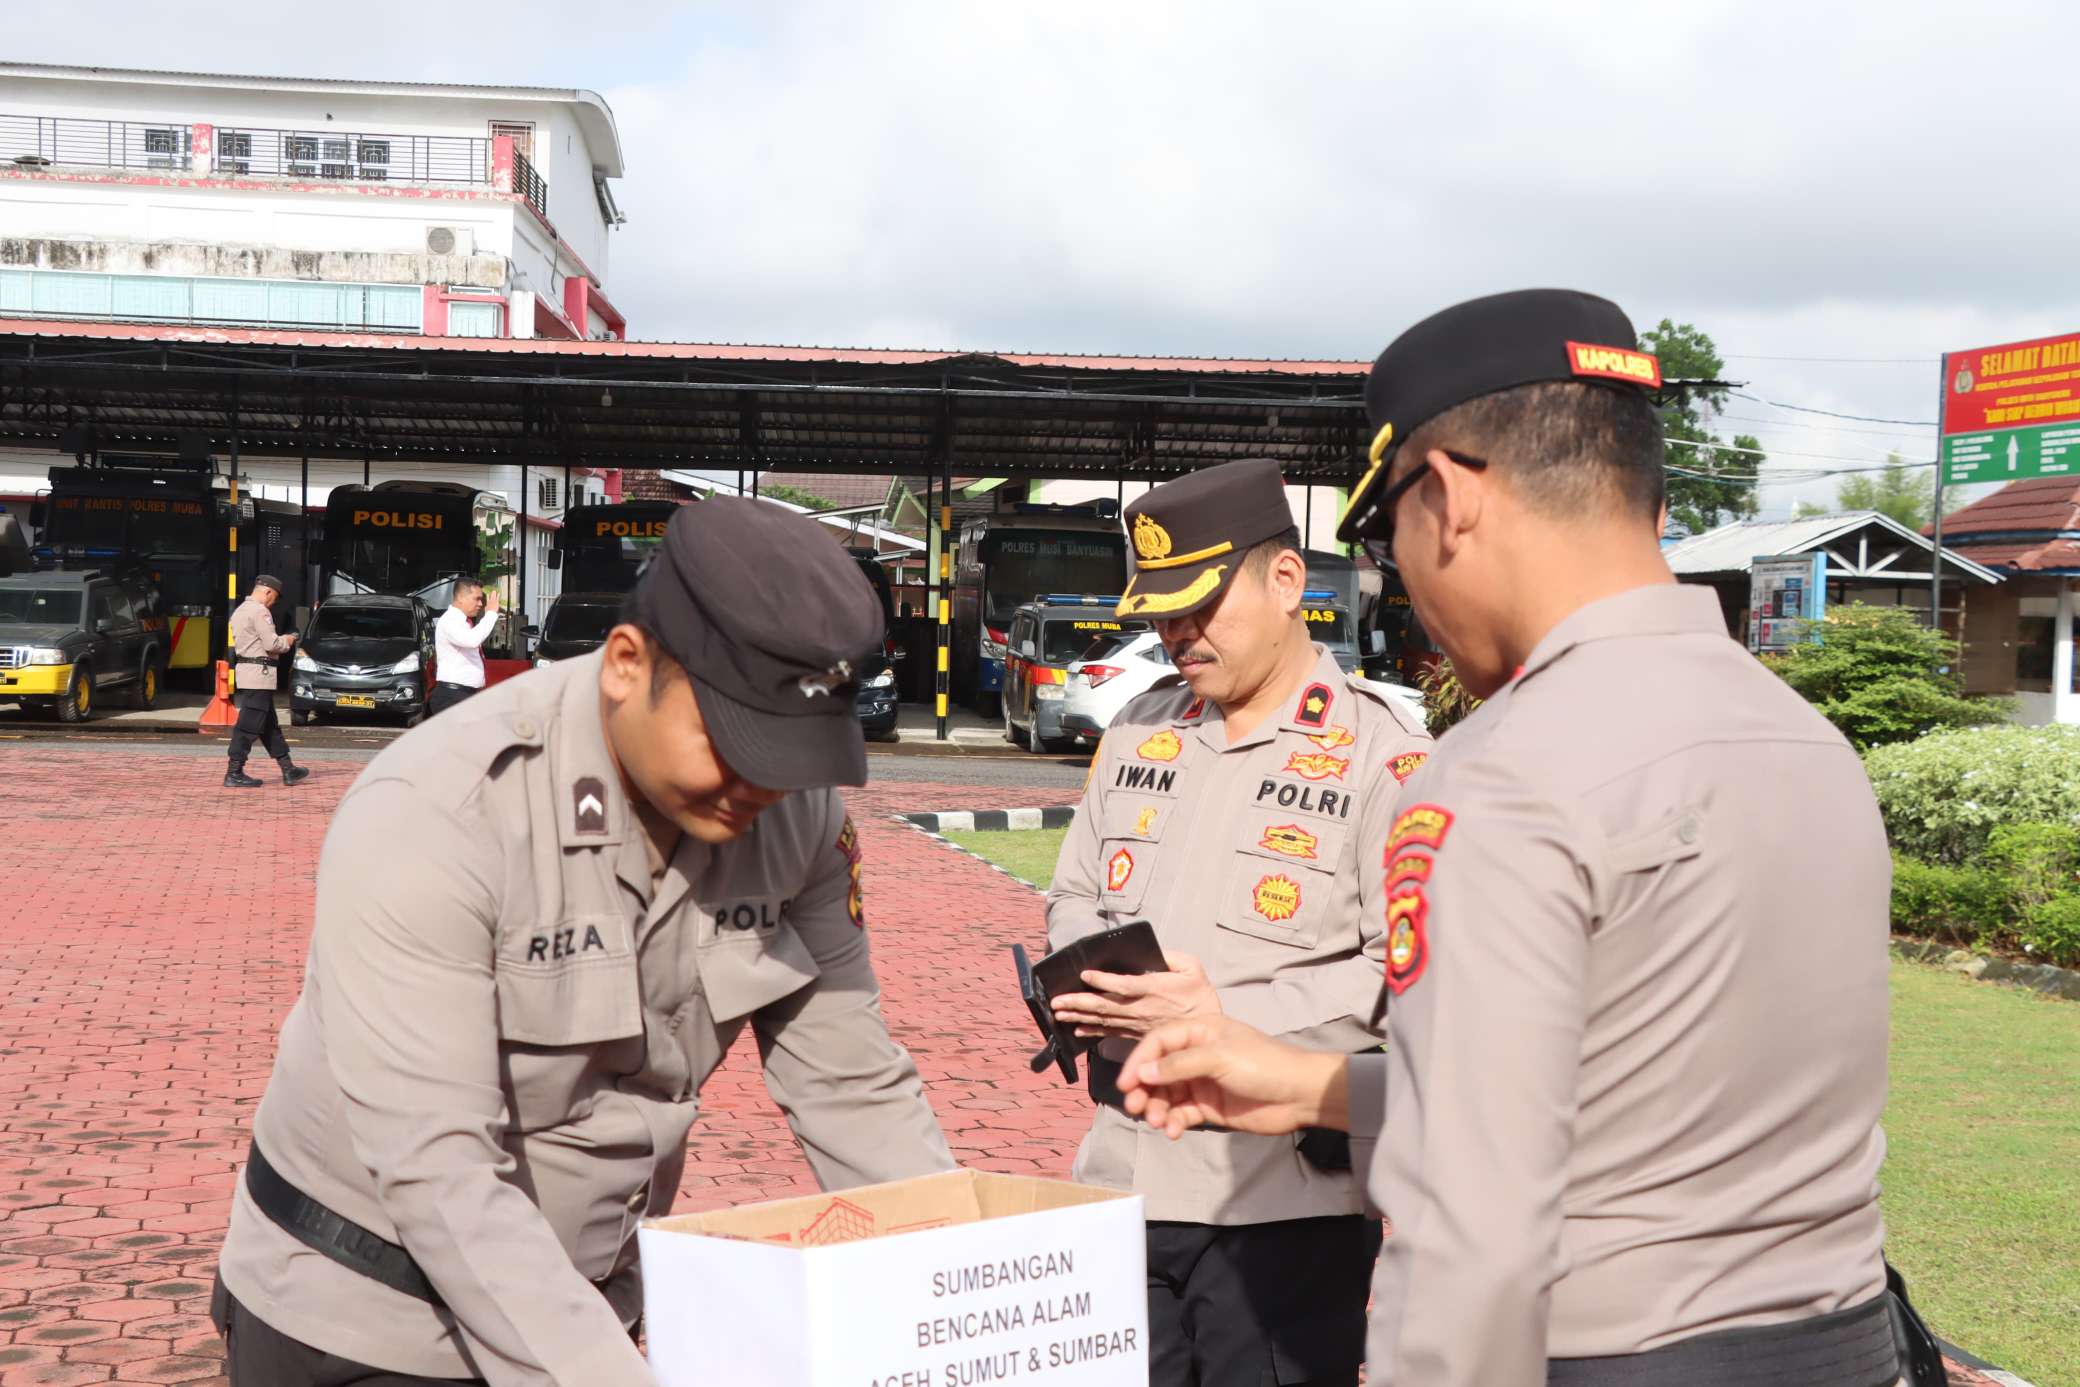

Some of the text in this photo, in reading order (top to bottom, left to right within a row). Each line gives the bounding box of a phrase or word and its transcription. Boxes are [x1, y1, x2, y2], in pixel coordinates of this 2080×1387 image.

[1981, 340, 2080, 377] SELAMAT DATA
[354, 510, 442, 529] POLISI
[596, 521, 667, 537] POLIS
[1001, 541, 1035, 553] POLRES
[1387, 595, 1411, 606] POL
[1074, 621, 1121, 631] POLRES MUBA
[1115, 764, 1177, 793] IWAN
[1256, 779, 1351, 819] POLRI
[714, 899, 792, 937] POLR
[527, 923, 605, 962] REZA
[931, 1248, 1074, 1298] SUMBANGAN
[916, 1291, 1092, 1348] BENCANA ALAM
[944, 1350, 1021, 1387] SUMUT
[1027, 1347, 1042, 1372] &
[1048, 1327, 1138, 1368] SUMBAR
